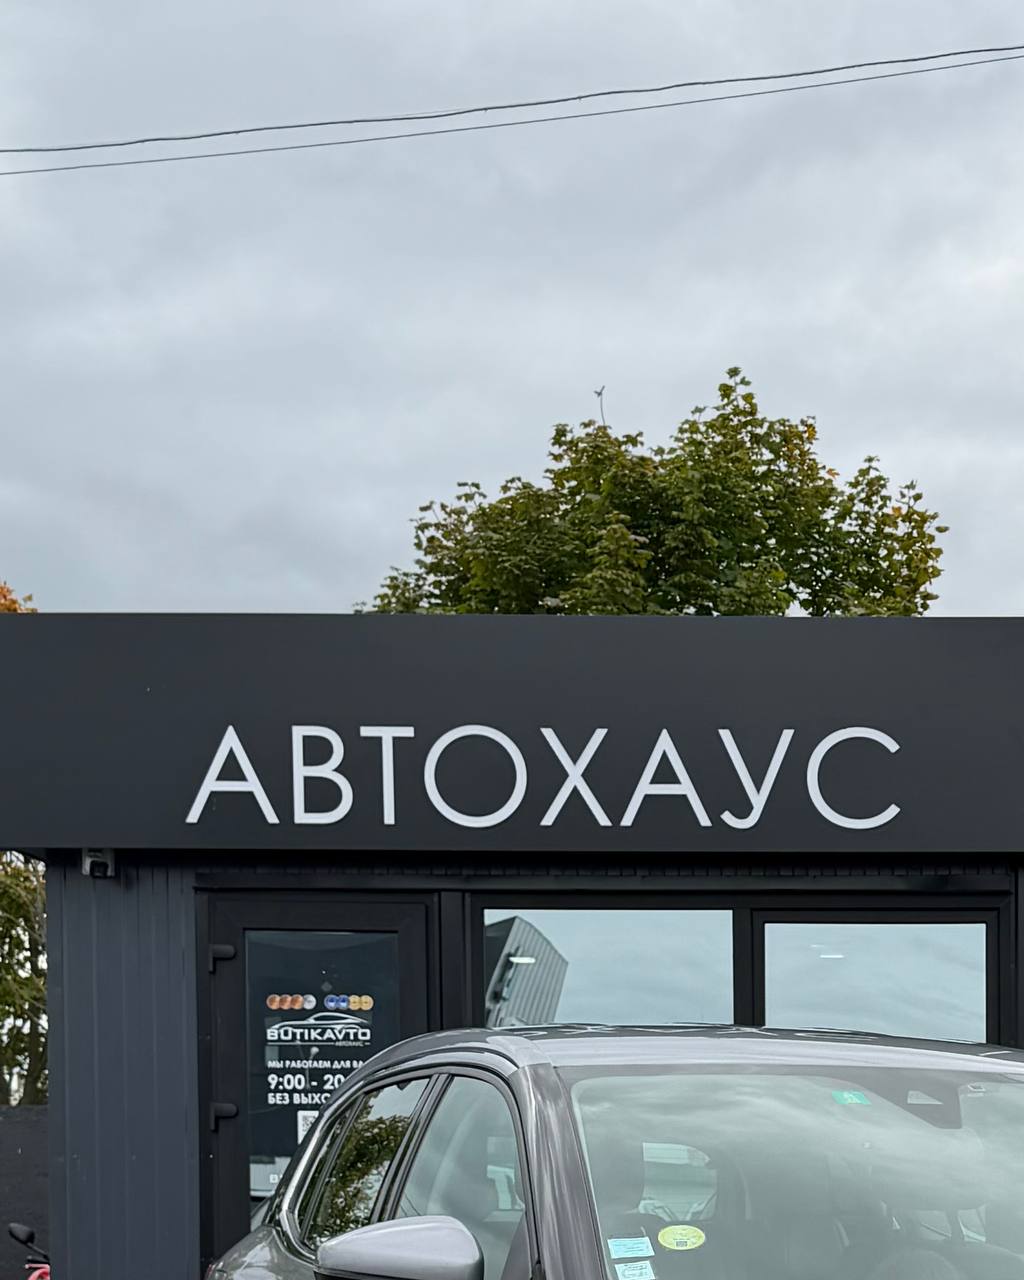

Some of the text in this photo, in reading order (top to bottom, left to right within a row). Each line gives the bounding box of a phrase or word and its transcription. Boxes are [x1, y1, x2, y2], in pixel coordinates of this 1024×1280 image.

[186, 725, 901, 829] АВТОХАУС
[266, 1028, 371, 1040] BUTIKAVTO
[267, 1060, 364, 1069] МЫ РАБОТАЕМ ДЛЯ ВА
[267, 1073, 305, 1090] 9:00
[267, 1092, 290, 1105] БЕЗ
